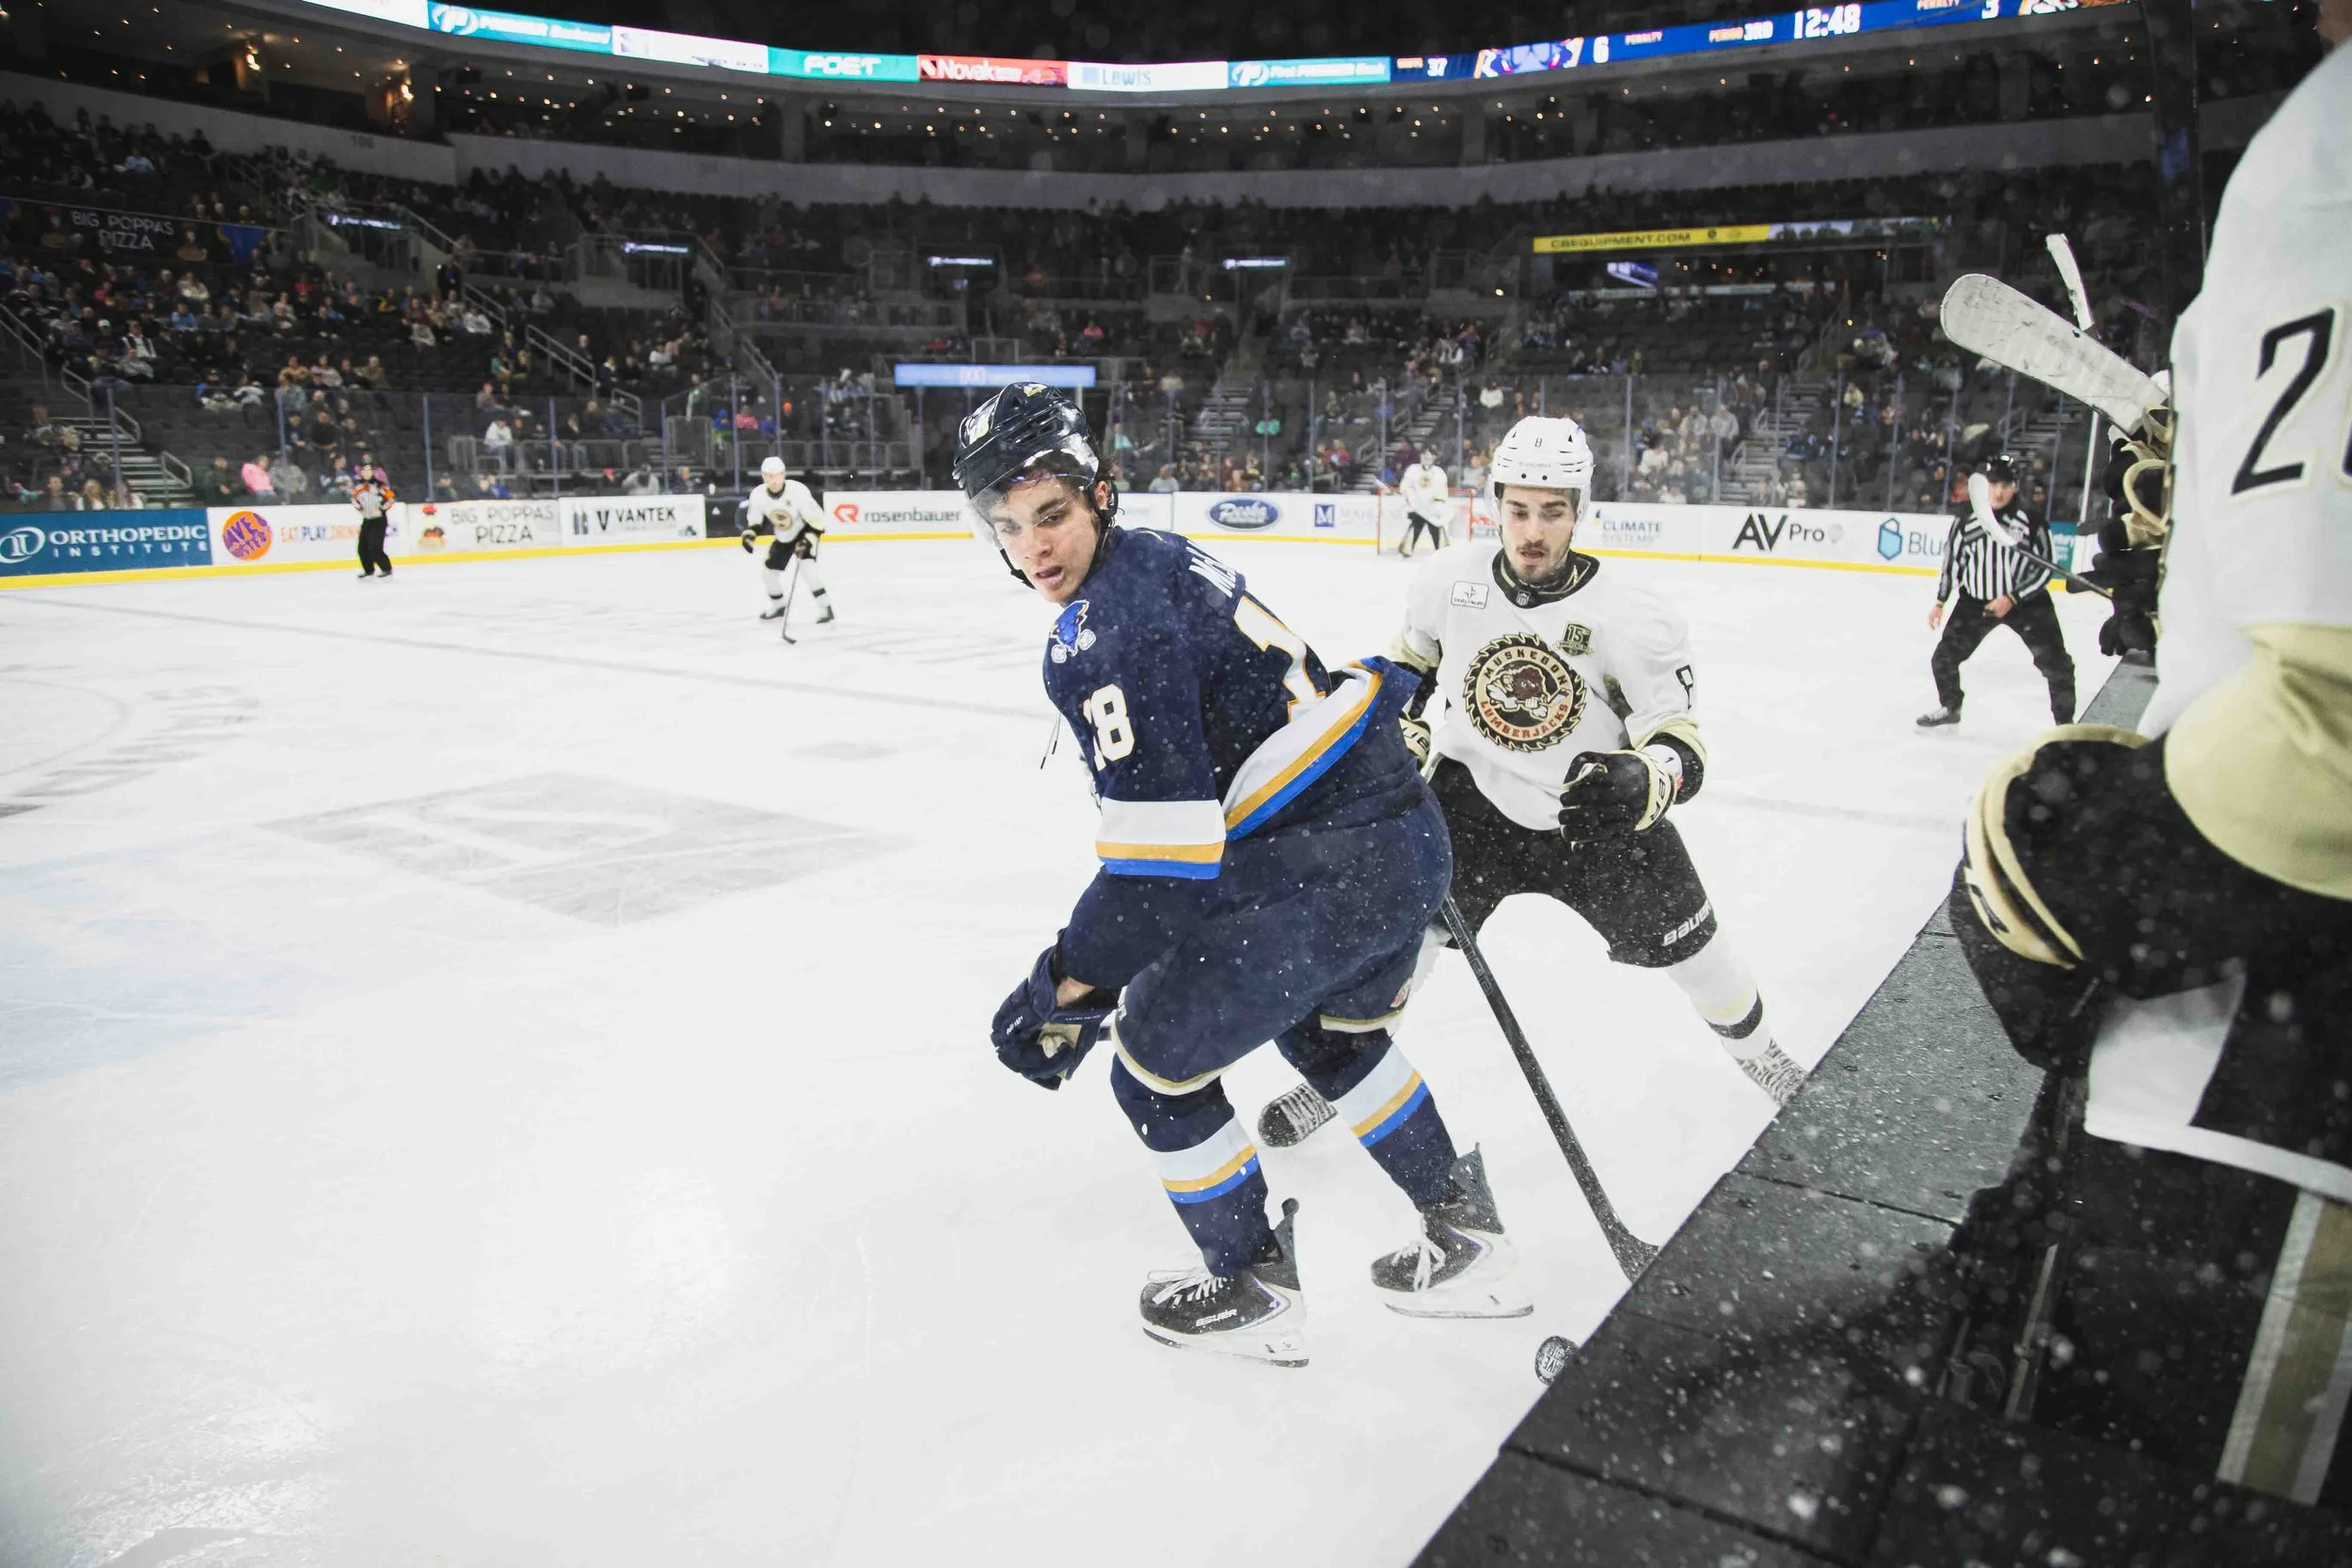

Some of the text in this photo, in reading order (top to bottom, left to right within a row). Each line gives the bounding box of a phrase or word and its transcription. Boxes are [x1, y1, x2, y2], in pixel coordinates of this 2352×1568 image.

[1793, 4, 1861, 40] 12:48
[1593, 36, 1610, 63] 6
[803, 55, 882, 76] POET
[1427, 57, 1448, 77] 37
[71, 211, 100, 228] BIG
[2231, 307, 2352, 497] 2
[451, 507, 478, 524] BIG
[615, 507, 676, 523] VANTEK
[864, 506, 961, 523] rosenbauer
[49, 524, 207, 546] ORTHOPEDIC
[475, 524, 533, 544] PIZZA
[1603, 519, 1662, 533] CLIMATE
[53, 541, 208, 559] INSTITUTE
[1484, 648, 1568, 685] MUSKEGON
[1480, 700, 1569, 738] LUMBERJACKS
